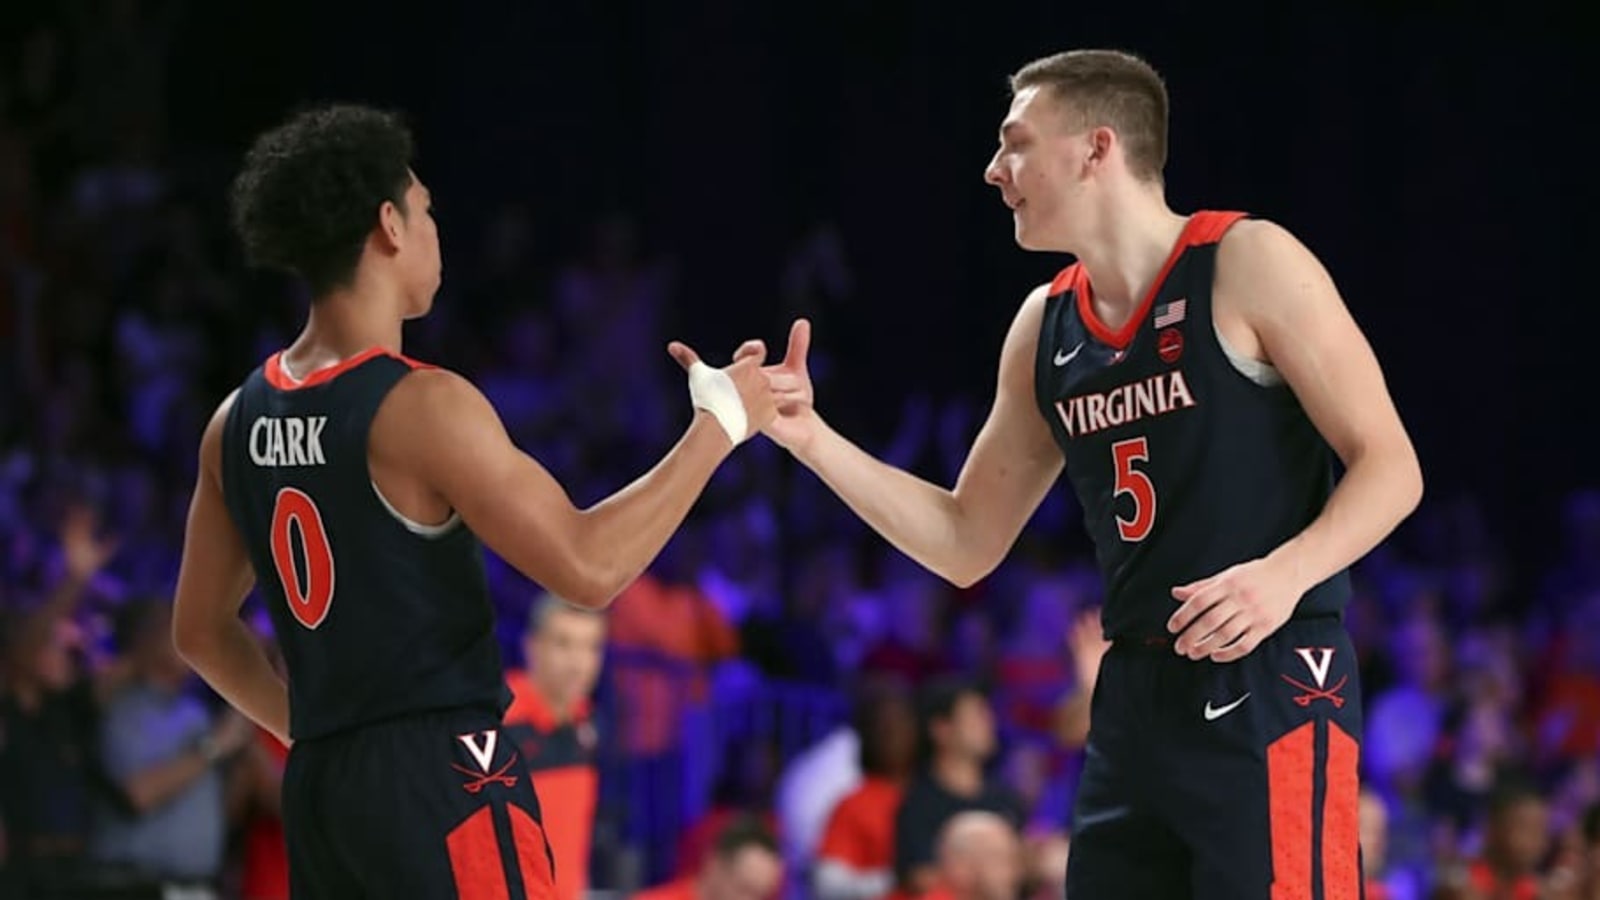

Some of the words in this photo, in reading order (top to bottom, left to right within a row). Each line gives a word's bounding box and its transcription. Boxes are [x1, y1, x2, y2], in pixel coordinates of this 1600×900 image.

[1054, 370, 1197, 437] VIRGINIA
[249, 416, 327, 466] CLARK
[1112, 437, 1156, 541] 5
[270, 487, 334, 630] 0
[1294, 648, 1335, 689] V
[457, 730, 497, 773] V
